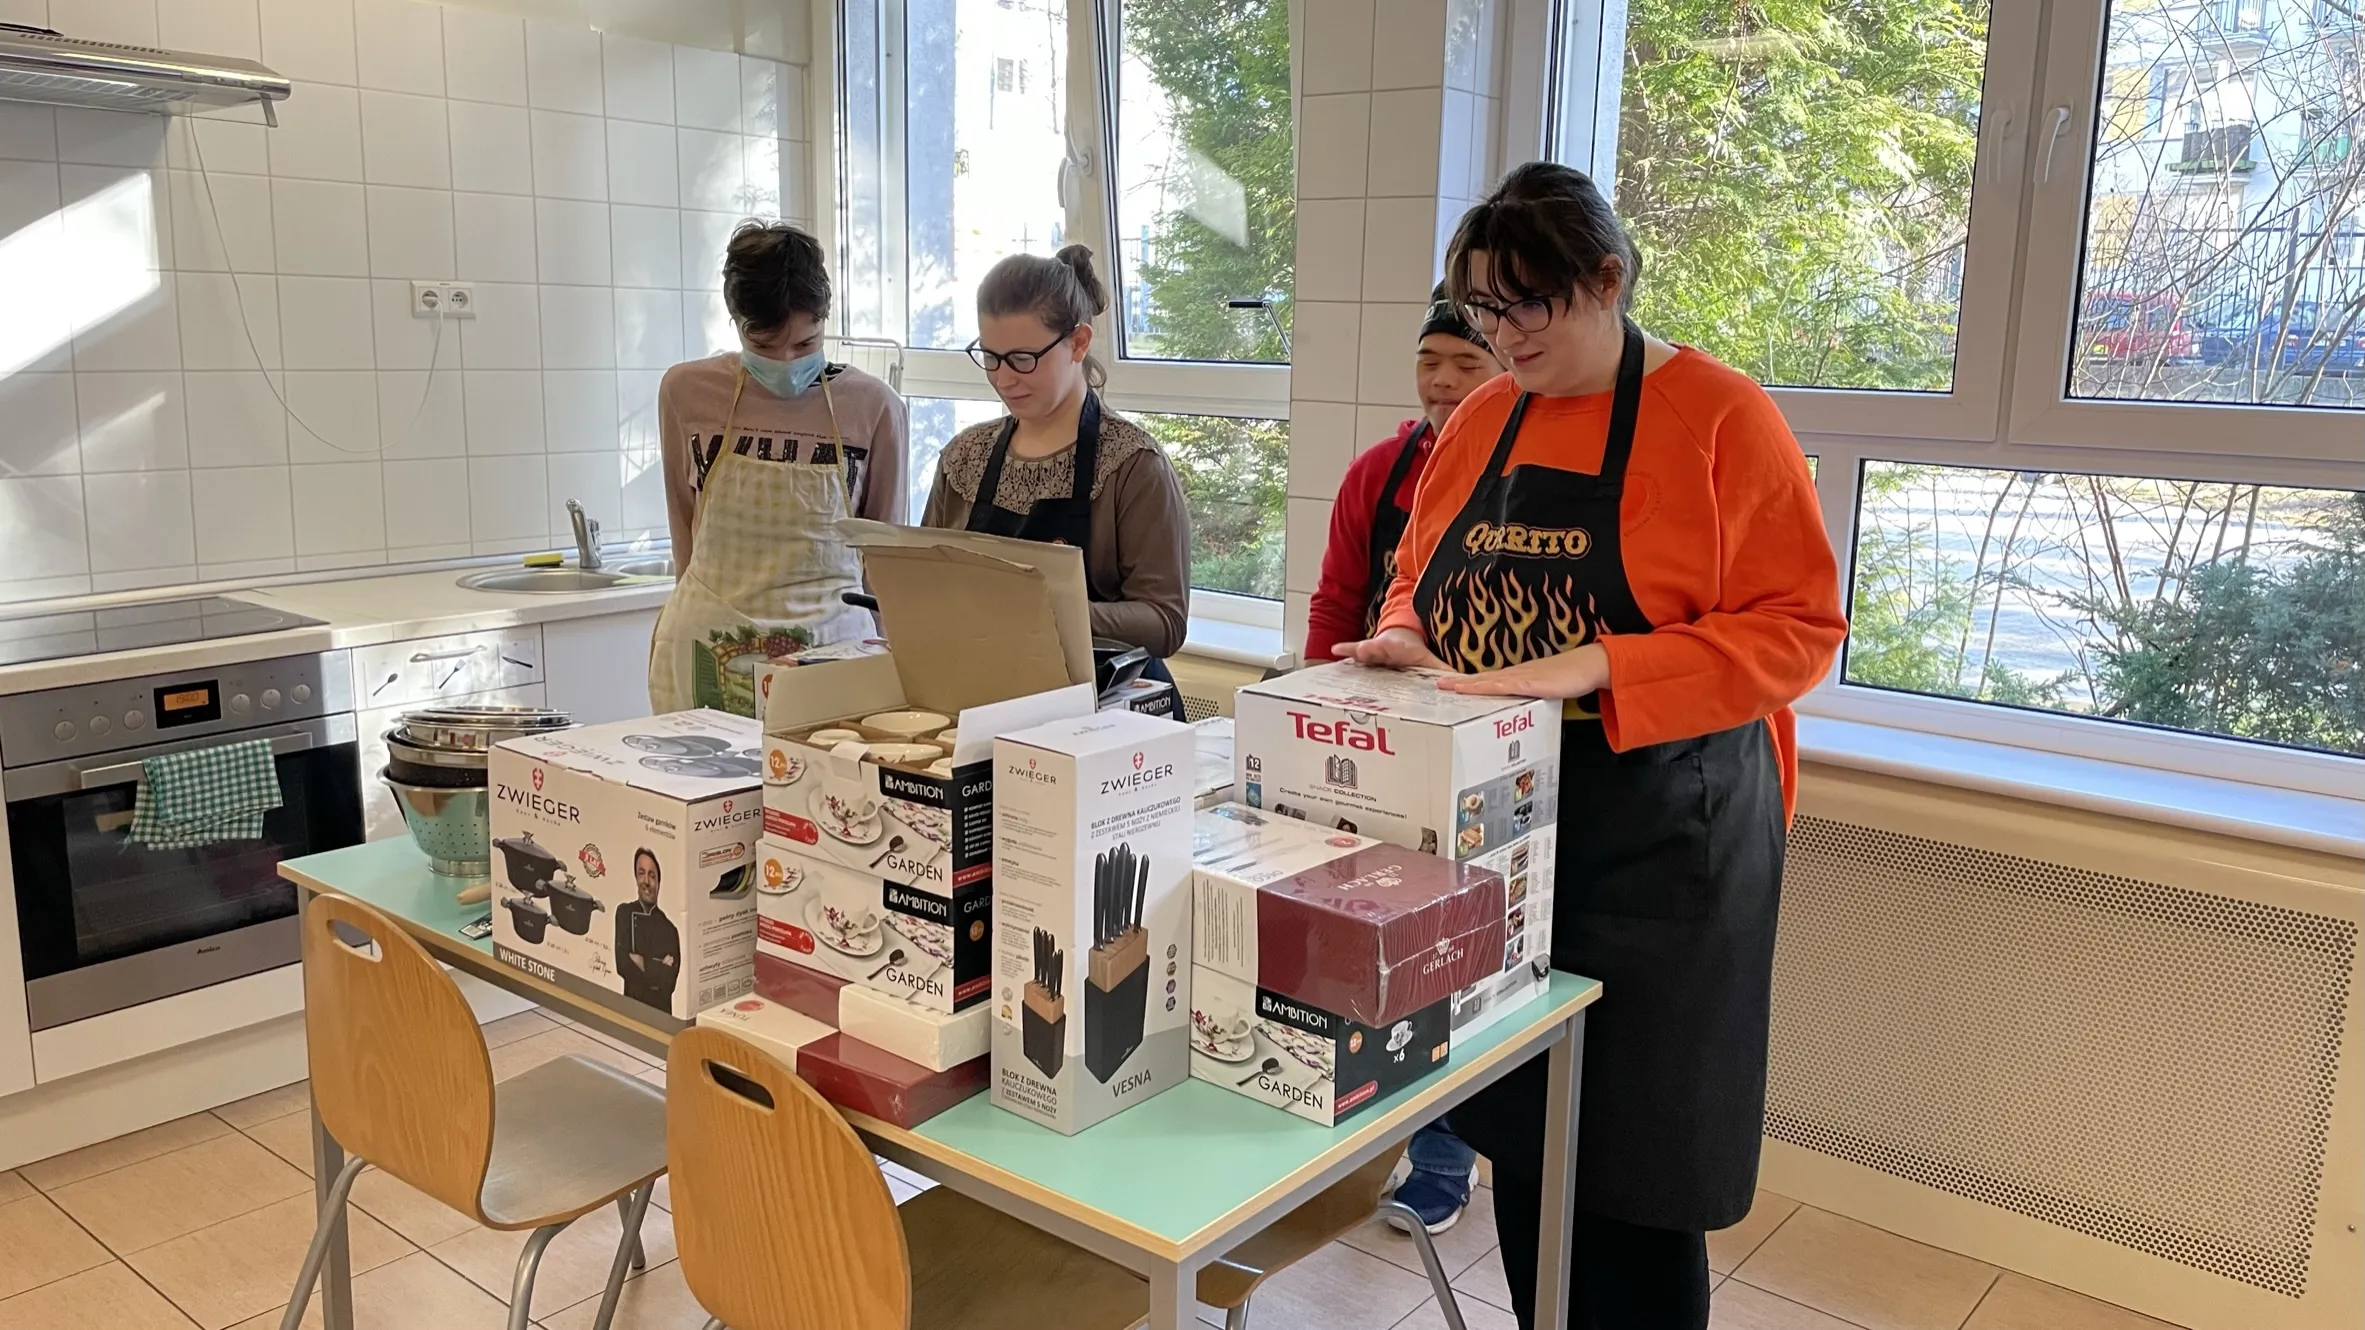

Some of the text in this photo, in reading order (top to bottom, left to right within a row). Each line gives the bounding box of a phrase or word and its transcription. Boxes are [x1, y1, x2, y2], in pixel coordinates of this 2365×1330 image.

[1286, 711, 1396, 756] Tefal
[1493, 710, 1534, 739] Tefal
[1009, 765, 1057, 785] ZWIEGER
[1250, 757, 1260, 769] 12
[895, 778, 944, 800] AMBITION
[1101, 764, 1173, 794] ZWIEGER
[1279, 787, 1301, 797] Create
[497, 783, 581, 824] ZWIEGER
[1334, 788, 1377, 802] COLLECTION
[694, 808, 761, 831] ZWIEGER
[765, 864, 776, 877] 12
[887, 854, 943, 882] GARDEN
[898, 892, 947, 917] AMBITION
[499, 947, 526, 969] WHITE
[528, 960, 555, 982] STONE
[1423, 947, 1464, 975] GERLACH
[886, 967, 943, 997] GARDEN
[1272, 1001, 1328, 1029] AMBITION
[1394, 1048, 1405, 1063] x6
[1002, 1068, 1019, 1080] BLOK
[1026, 1077, 1057, 1096] DREWNA
[1112, 1069, 1152, 1098] VESNA
[1258, 1075, 1323, 1110] GARDEN
